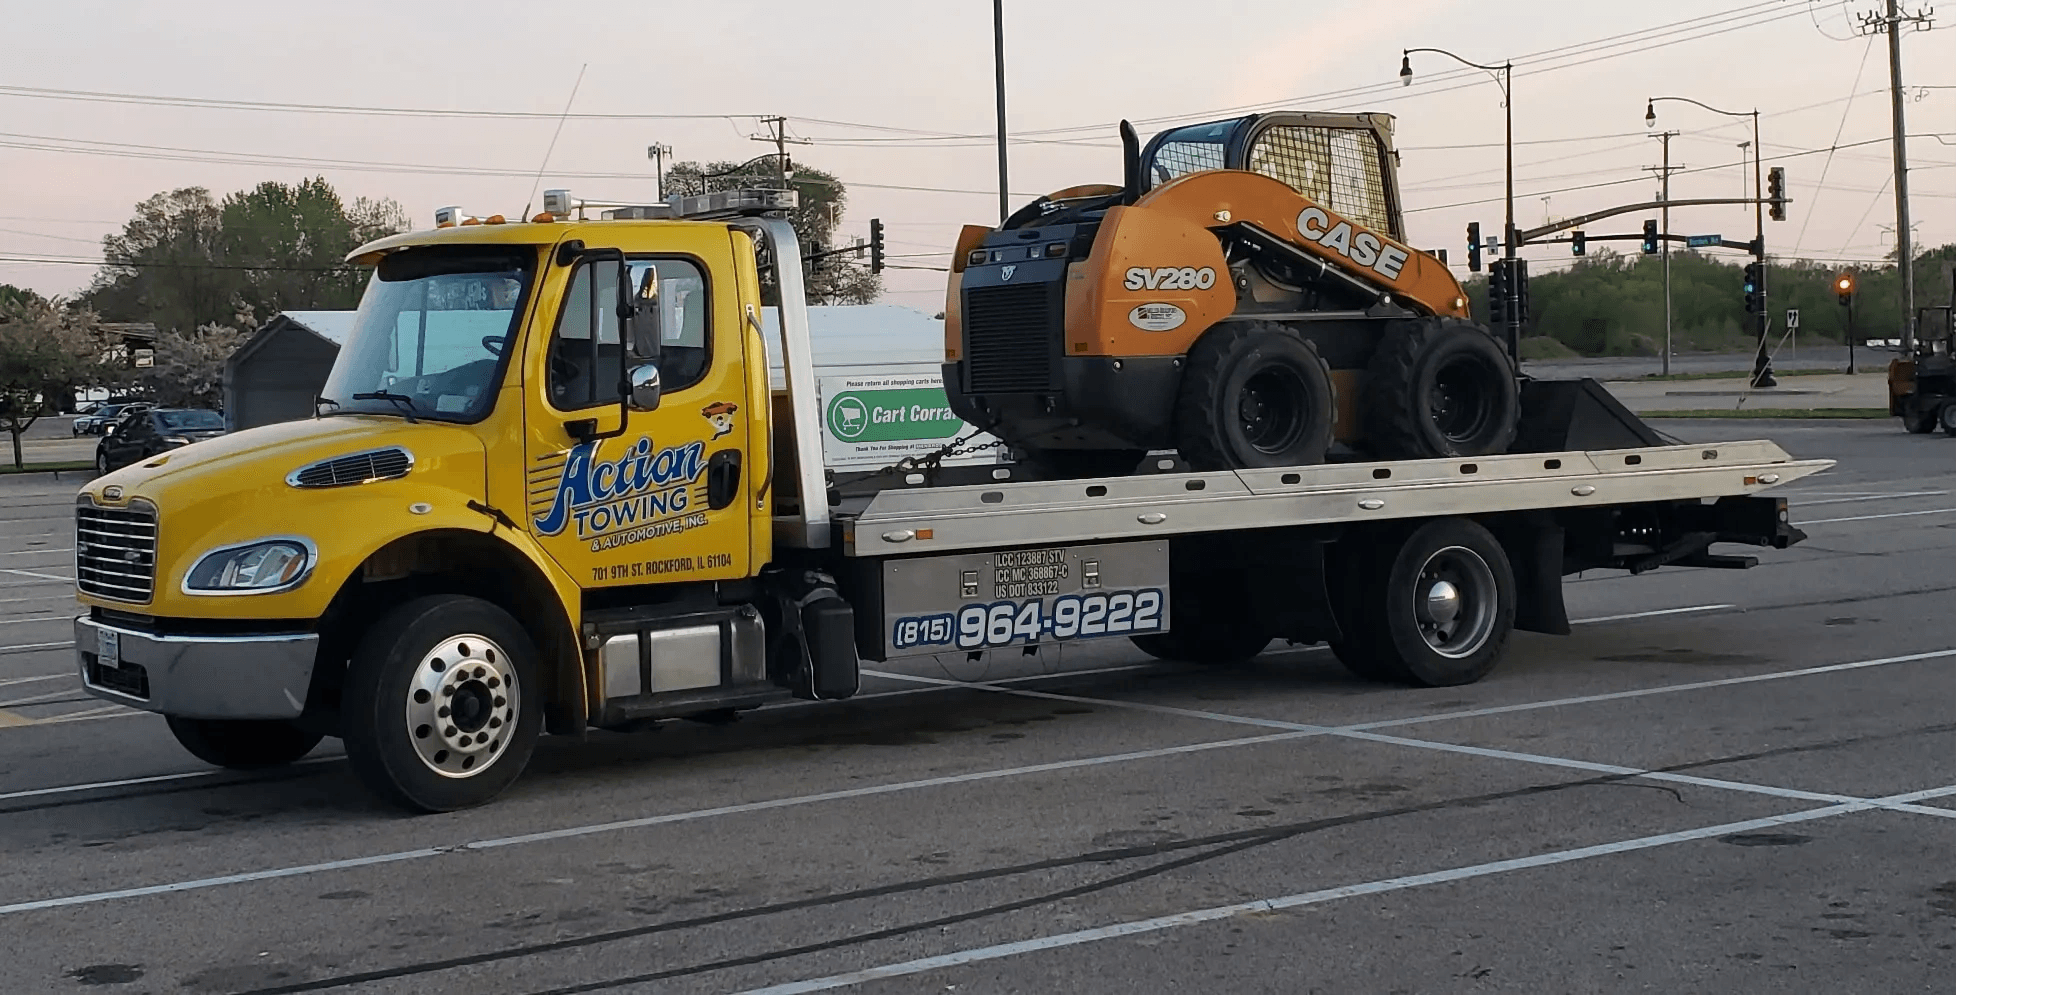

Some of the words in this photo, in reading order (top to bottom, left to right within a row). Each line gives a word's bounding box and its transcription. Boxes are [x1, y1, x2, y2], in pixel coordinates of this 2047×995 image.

[1296, 206, 1409, 281] CASE
[1123, 266, 1217, 291] SV280
[864, 379, 882, 387] return
[872, 406, 906, 424] Cart
[533, 436, 709, 536] Action
[573, 487, 688, 537] TOWING
[591, 538, 600, 552] &
[601, 519, 683, 551] AUTOMOTIVE,
[684, 513, 708, 530] INC.
[592, 566, 608, 581] 701
[611, 563, 628, 579] 9TH
[631, 562, 644, 577] ST.
[646, 557, 695, 575] ROCKFORD,
[697, 555, 704, 570] IL
[707, 553, 732, 568] 61104
[995, 553, 1014, 567] ILCC
[1016, 550, 1047, 566] 123887
[1048, 549, 1066, 563] STV
[995, 569, 1010, 583] ICC
[1012, 568, 1026, 582] MC
[1028, 564, 1068, 580] 368867-C
[995, 584, 1007, 599] US
[1008, 583, 1026, 597] DOT
[1027, 580, 1058, 596] 833122
[895, 616, 952, 648] (815)
[957, 589, 1162, 648] 964-9222
